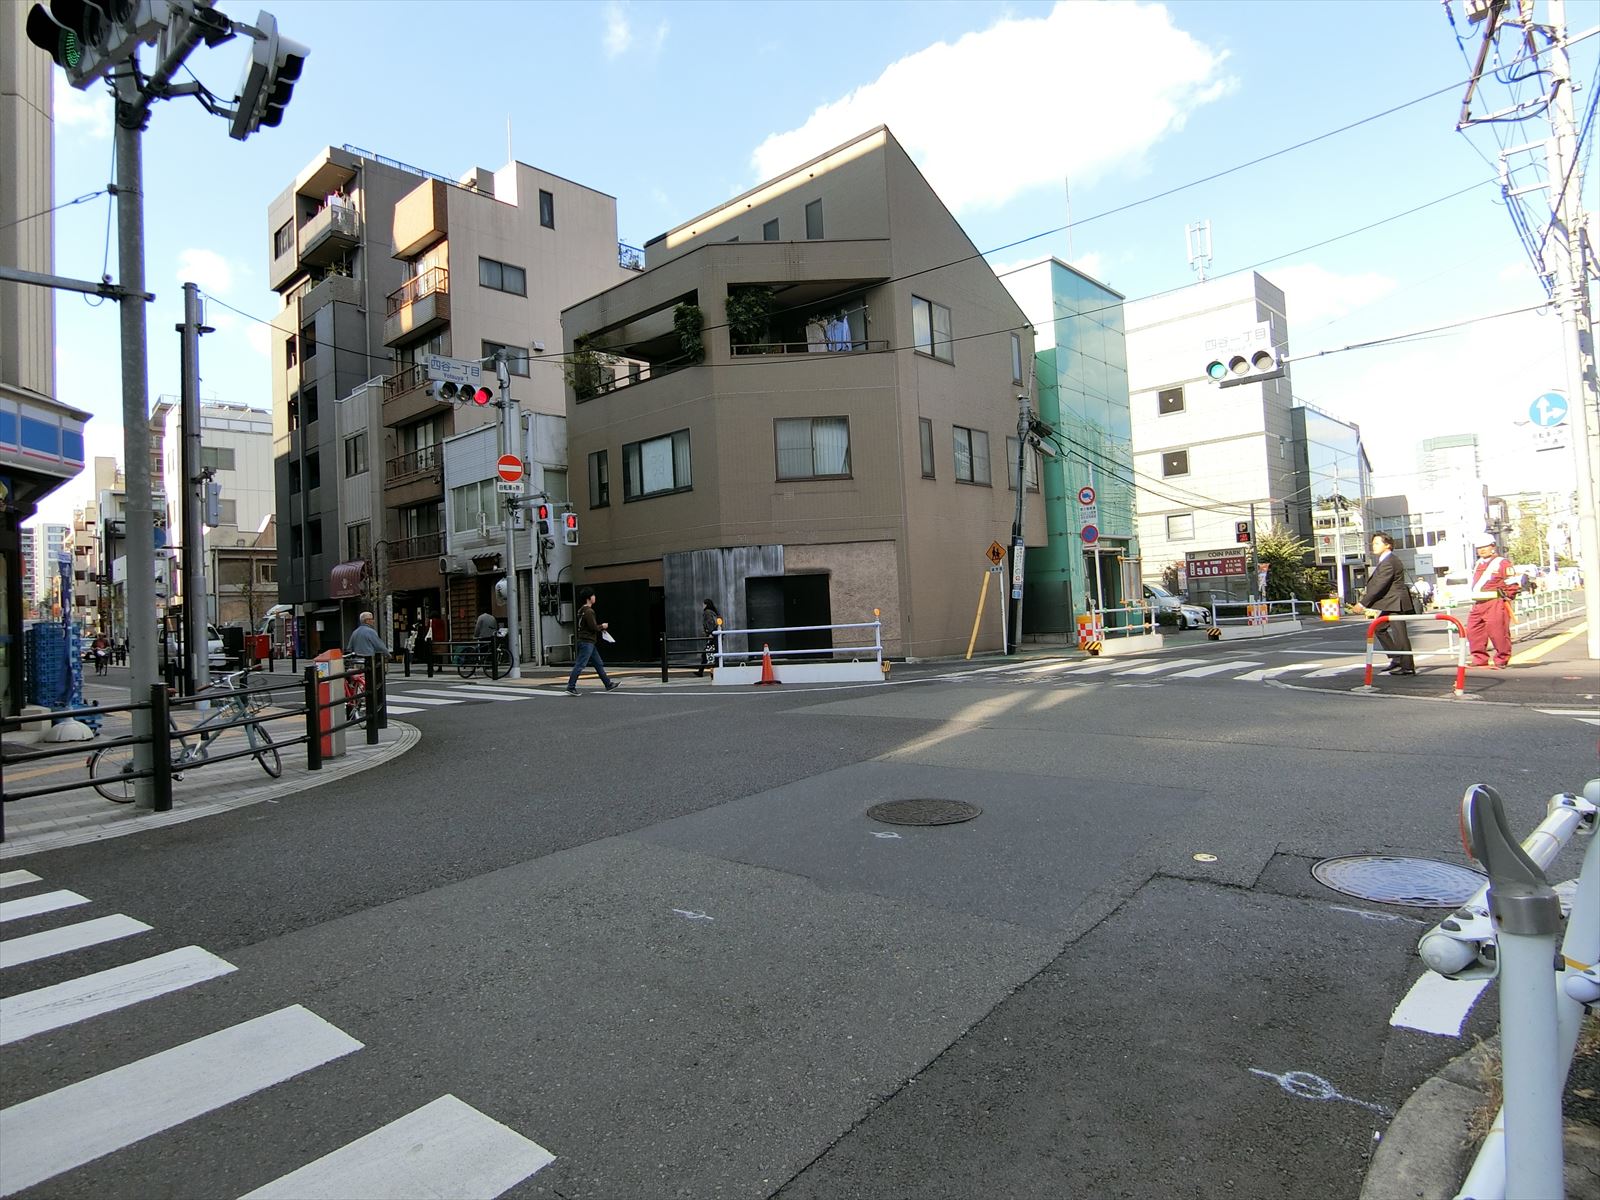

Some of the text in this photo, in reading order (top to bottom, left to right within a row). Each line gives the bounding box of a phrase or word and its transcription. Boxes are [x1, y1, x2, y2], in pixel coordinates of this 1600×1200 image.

[1205, 328, 1266, 351] 四谷一丁目
[431, 360, 480, 377] 四谷一丁目
[1196, 566, 1218, 575] 500
